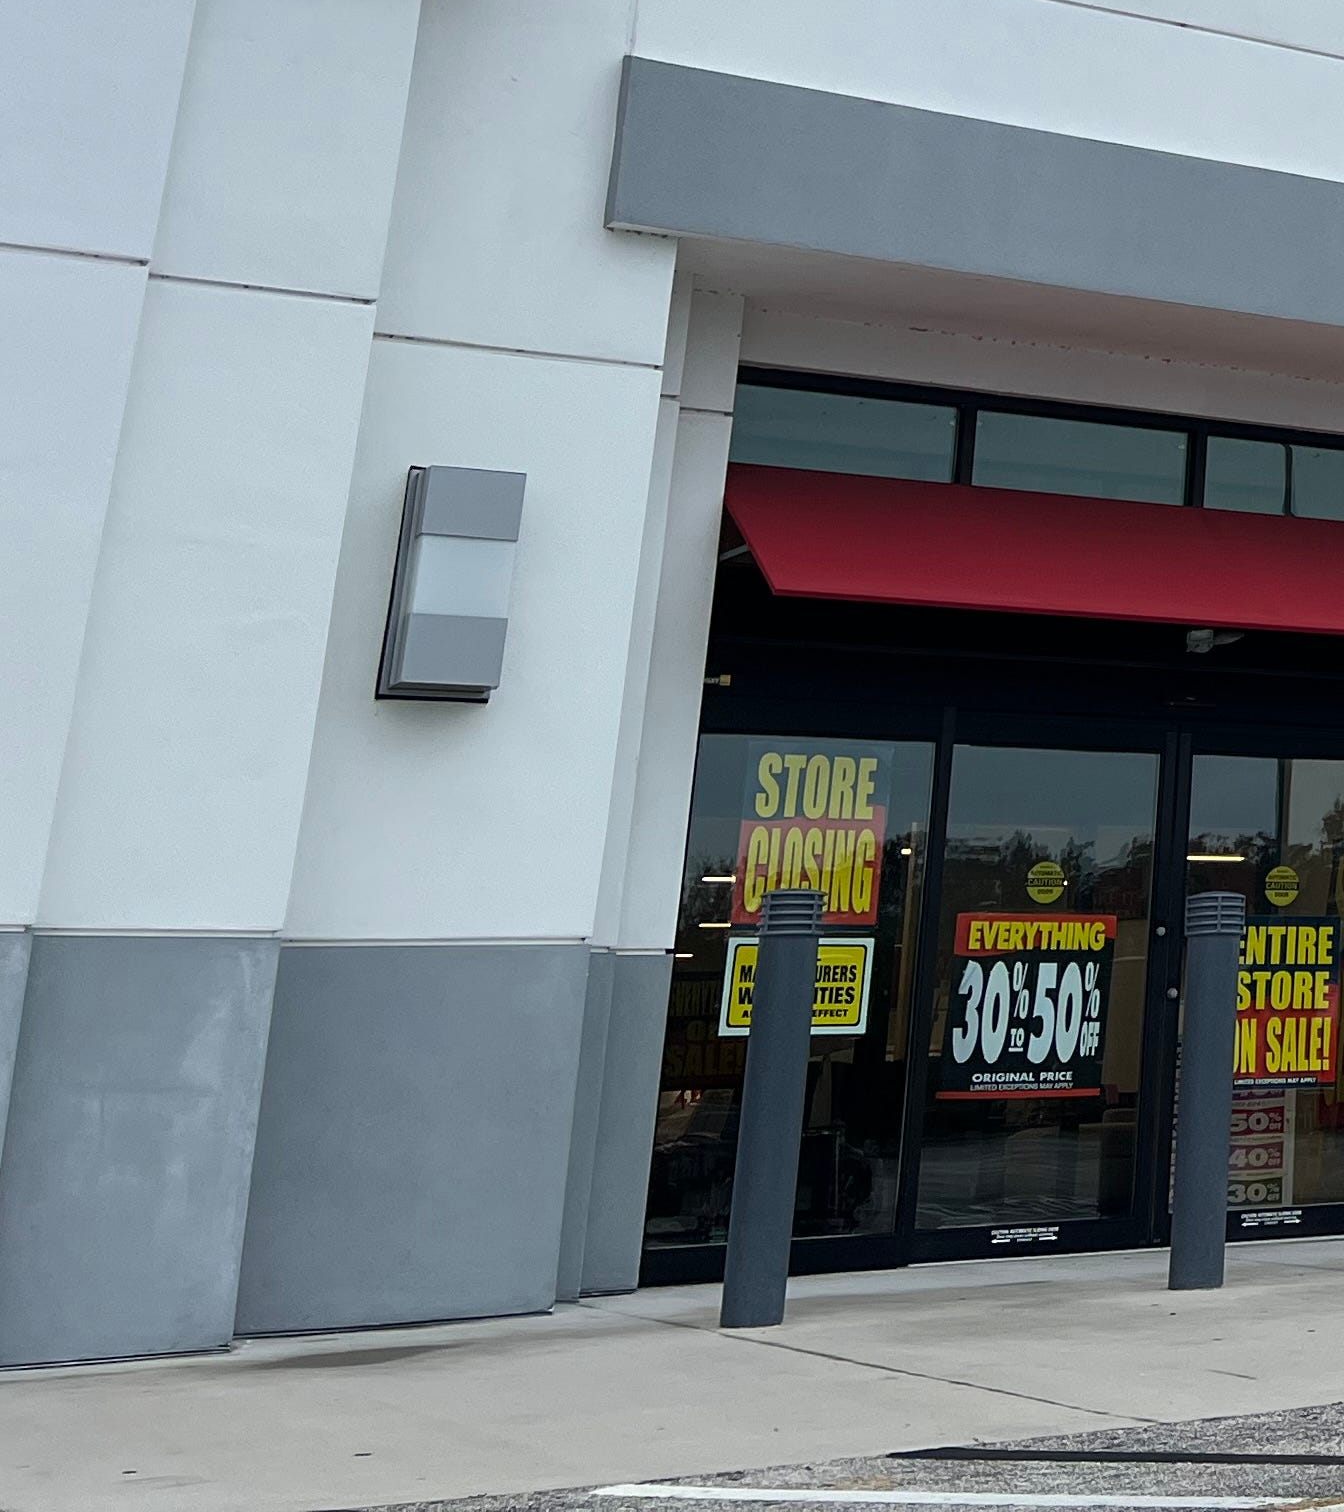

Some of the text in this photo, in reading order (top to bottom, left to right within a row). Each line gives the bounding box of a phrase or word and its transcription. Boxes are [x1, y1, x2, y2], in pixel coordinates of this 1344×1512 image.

[755, 752, 878, 820] STORE
[743, 826, 876, 915] CLOSING
[968, 920, 1106, 952] EVERYTHING
[1236, 971, 1330, 1010] STORE
[1009, 1028, 1025, 1048] TO
[1079, 1021, 1101, 1058] OFF
[1265, 1016, 1332, 1073] SALE!
[972, 1071, 1073, 1083] ORIGINAL PRICE
